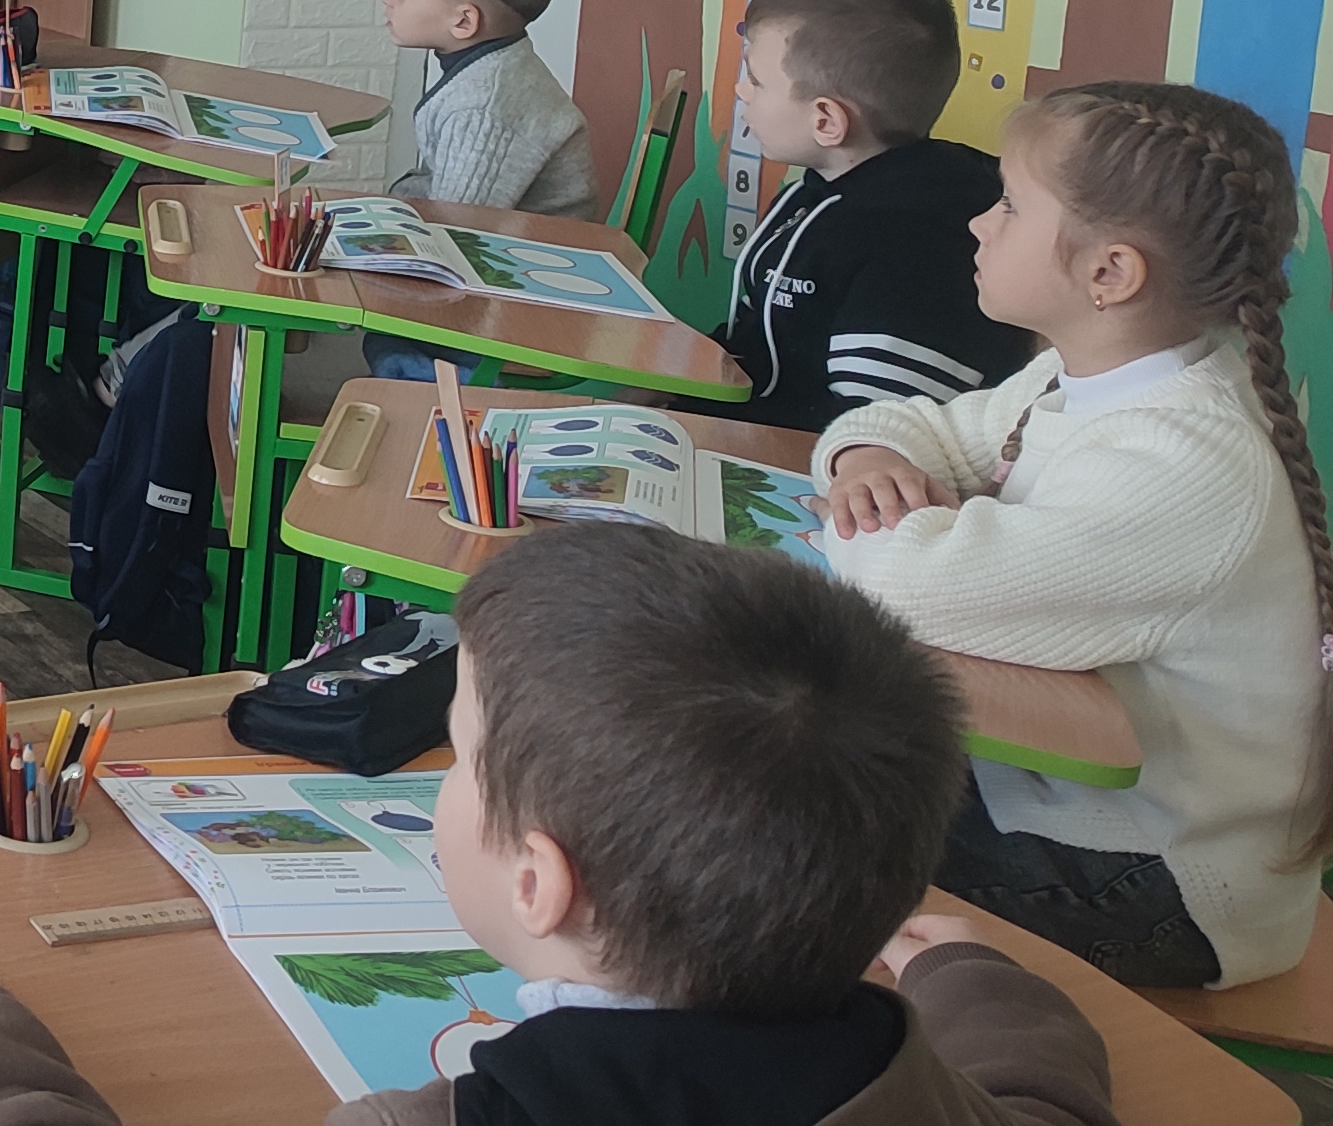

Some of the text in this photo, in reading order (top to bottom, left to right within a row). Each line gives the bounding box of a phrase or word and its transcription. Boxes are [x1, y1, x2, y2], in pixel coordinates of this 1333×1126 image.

[735, 170, 749, 193] 8
[733, 223, 747, 246] 9
[791, 277, 816, 295] NO
[158, 494, 179, 506] KITE
